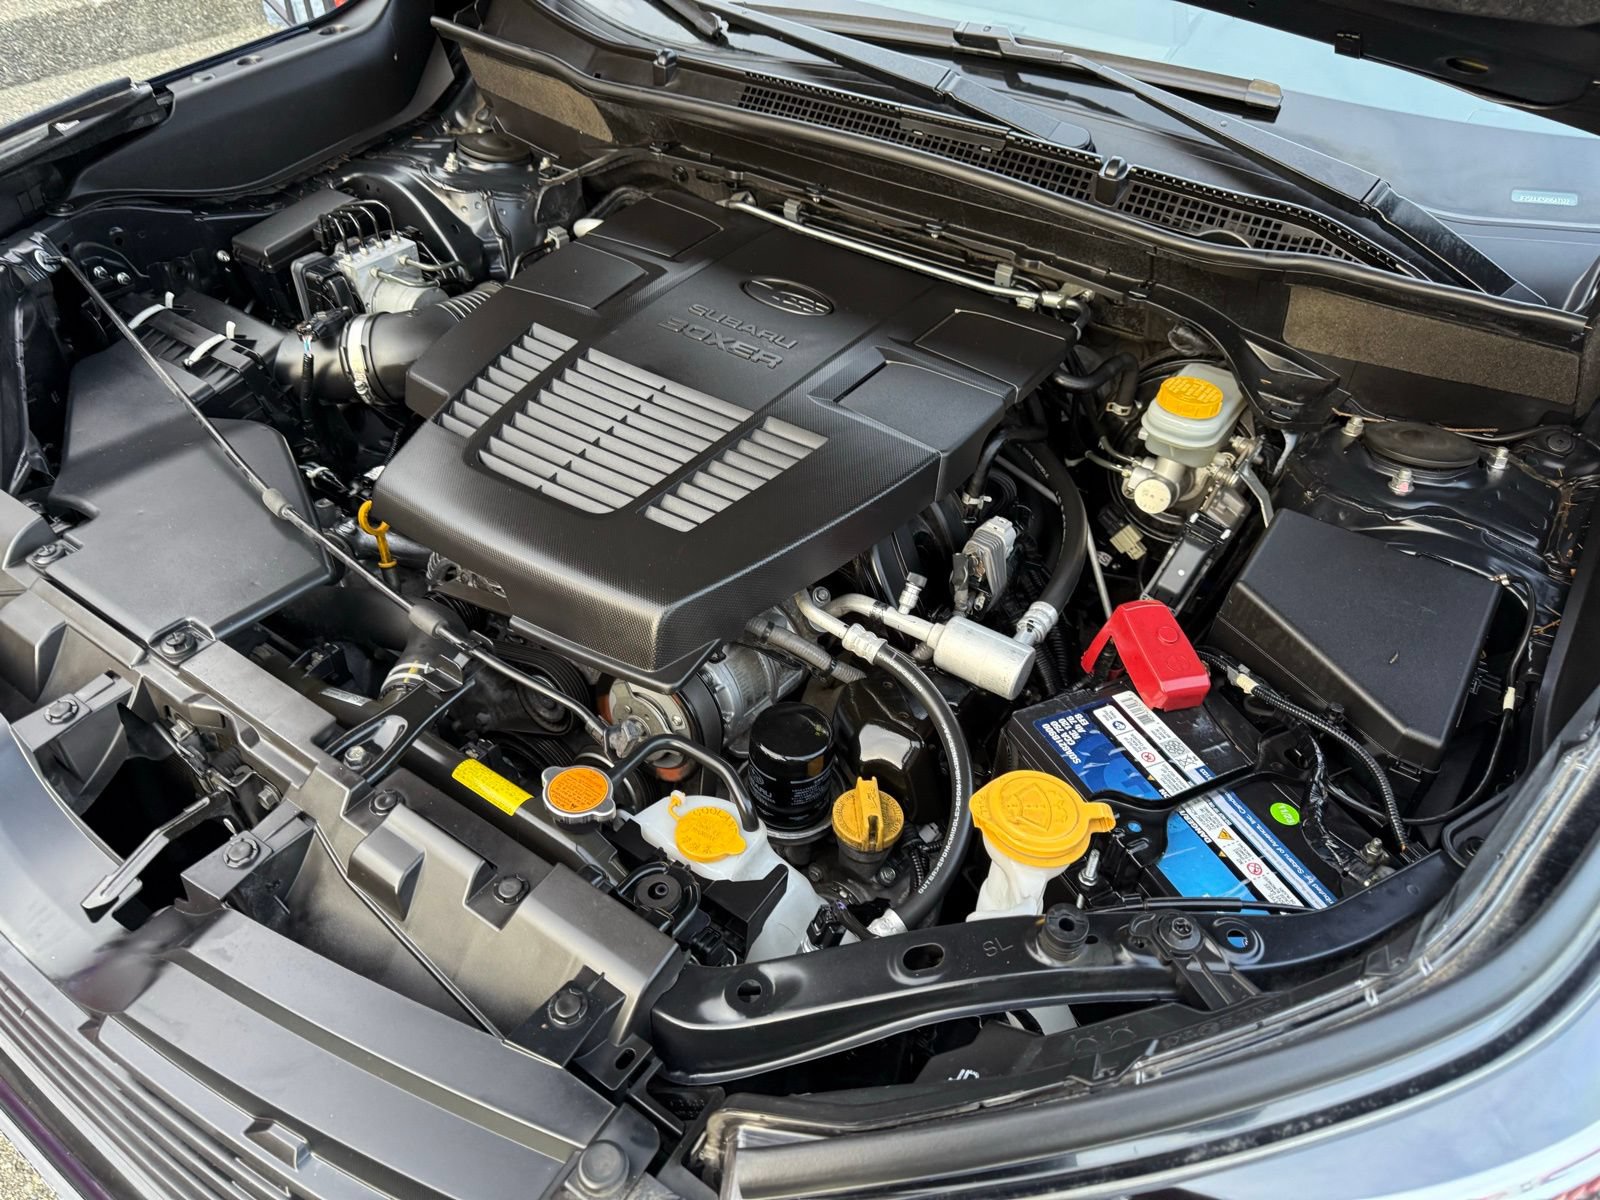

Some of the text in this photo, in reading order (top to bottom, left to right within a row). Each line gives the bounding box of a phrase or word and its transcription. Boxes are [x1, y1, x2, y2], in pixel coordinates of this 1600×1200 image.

[688, 303, 798, 349] SUBARU
[658, 318, 784, 369] BOXER
[1057, 717, 1081, 740] RC 120
[1074, 712, 1089, 726] EFB
[1049, 719, 1075, 745] CCA 750
[1283, 853, 1304, 872] Subaru
[983, 937, 1014, 957] SL
